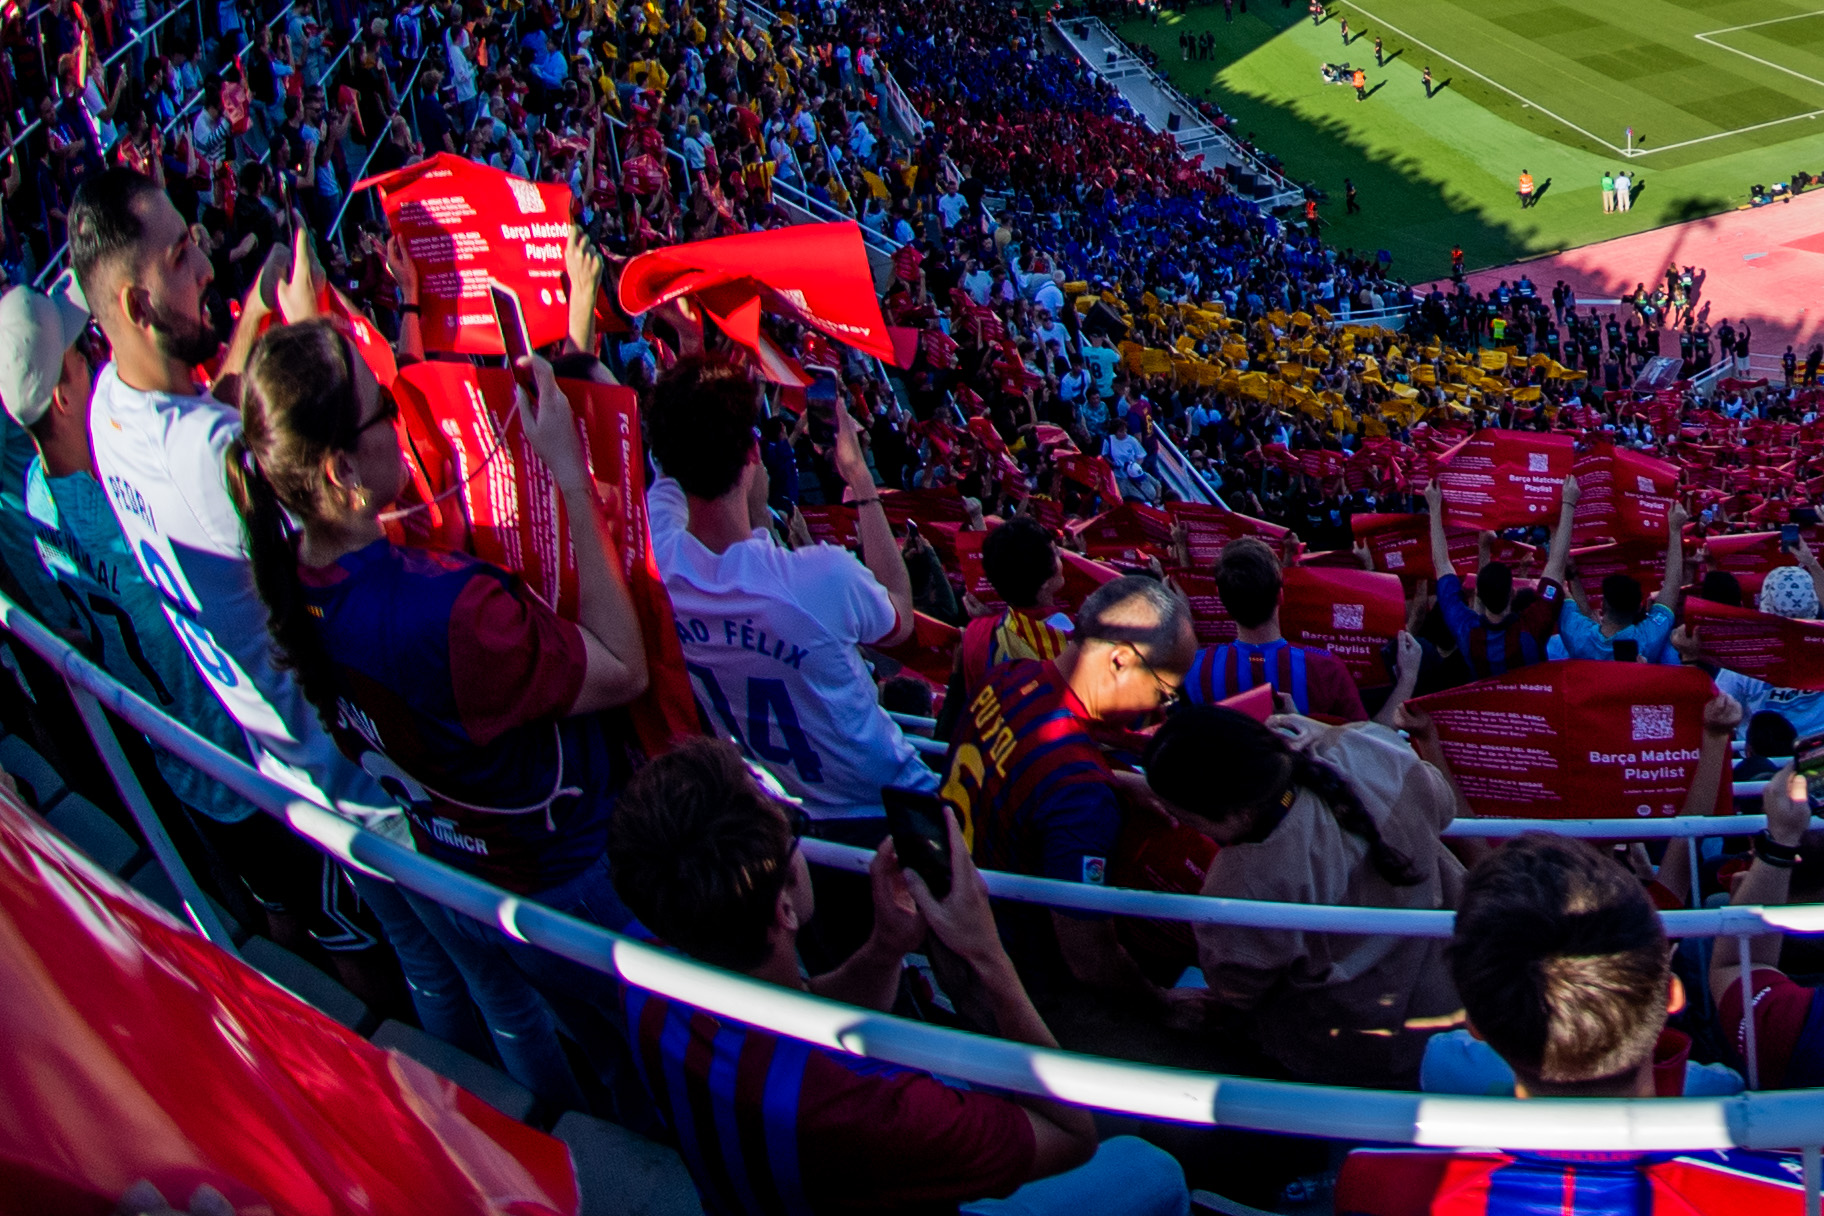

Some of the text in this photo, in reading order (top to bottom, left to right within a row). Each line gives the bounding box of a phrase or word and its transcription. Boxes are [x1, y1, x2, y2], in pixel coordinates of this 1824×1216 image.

[501, 222, 571, 242] Barça Matchd
[525, 243, 562, 263] Playlist
[1524, 484, 1553, 493] Playlist
[1532, 475, 1564, 485] Matchda
[109, 476, 158, 534] PEDRI
[724, 618, 809, 670] FÉLIX
[1301, 630, 1388, 644] Barça Matchda
[1326, 643, 1370, 655] Playlist
[1520, 684, 1553, 693] Madrid
[687, 661, 824, 784] 14
[970, 684, 1018, 779] PUYOL
[1589, 748, 1700, 765] Barça Matchd
[1625, 766, 1685, 781] Playlist
[432, 826, 489, 857] UNHCR
